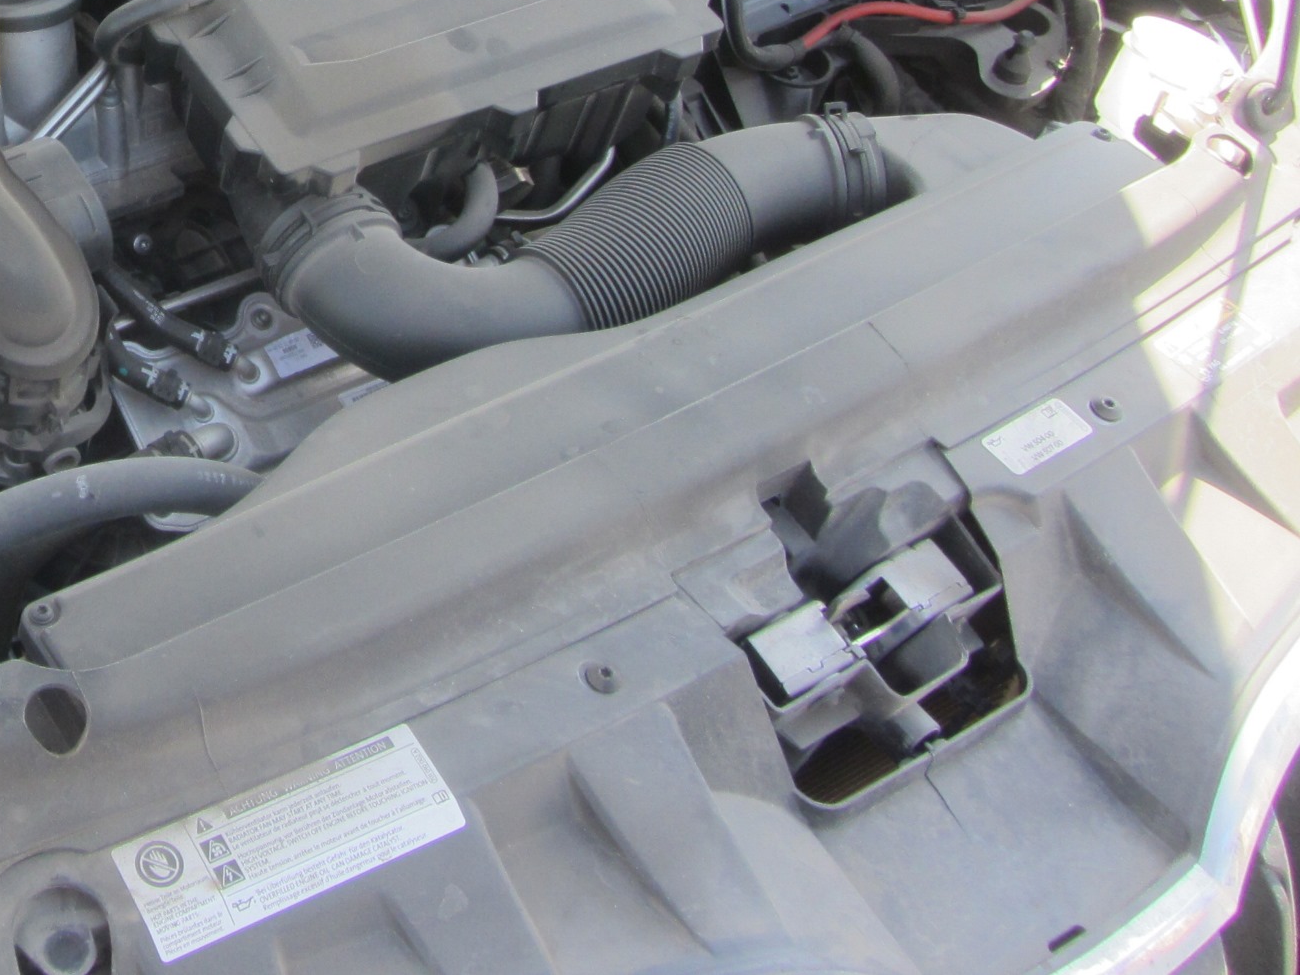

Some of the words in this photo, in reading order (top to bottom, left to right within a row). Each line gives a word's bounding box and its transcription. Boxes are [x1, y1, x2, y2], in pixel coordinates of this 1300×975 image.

[1031, 434, 1046, 445] 504
[1042, 429, 1055, 439] 00
[1041, 443, 1056, 454] 507
[1051, 438, 1064, 448] 00
[225, 787, 279, 817] ACHTUNG
[331, 739, 387, 770] ATTENTION
